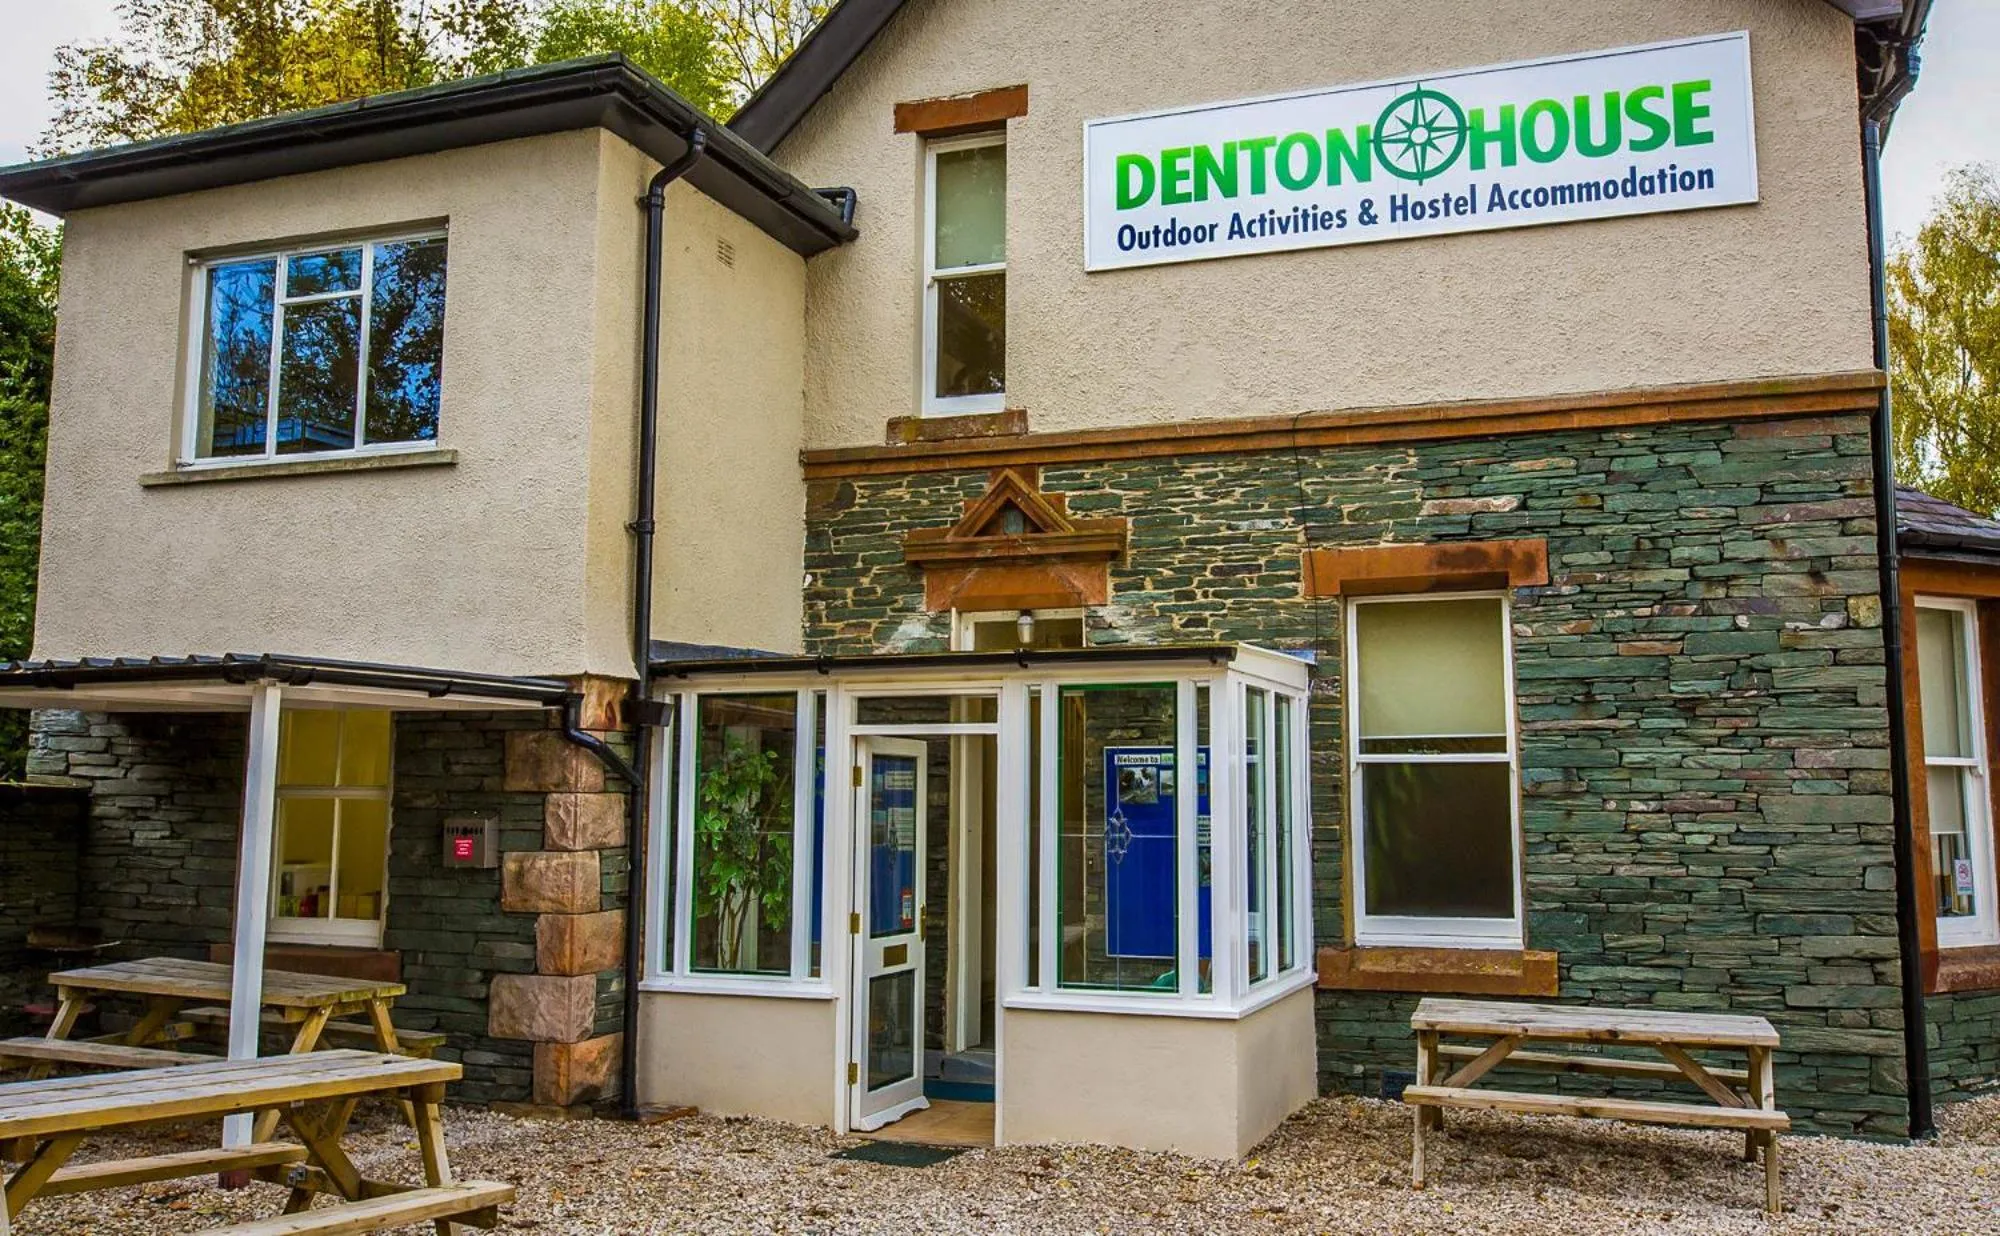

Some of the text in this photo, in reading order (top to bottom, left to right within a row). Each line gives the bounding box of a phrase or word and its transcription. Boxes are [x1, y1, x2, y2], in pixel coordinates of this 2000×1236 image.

[1115, 79, 1714, 211] DENTON HOUSE
[1117, 163, 1715, 251] Outdoor Activities & Hostel Accommodation
[1150, 755, 1159, 764] to
